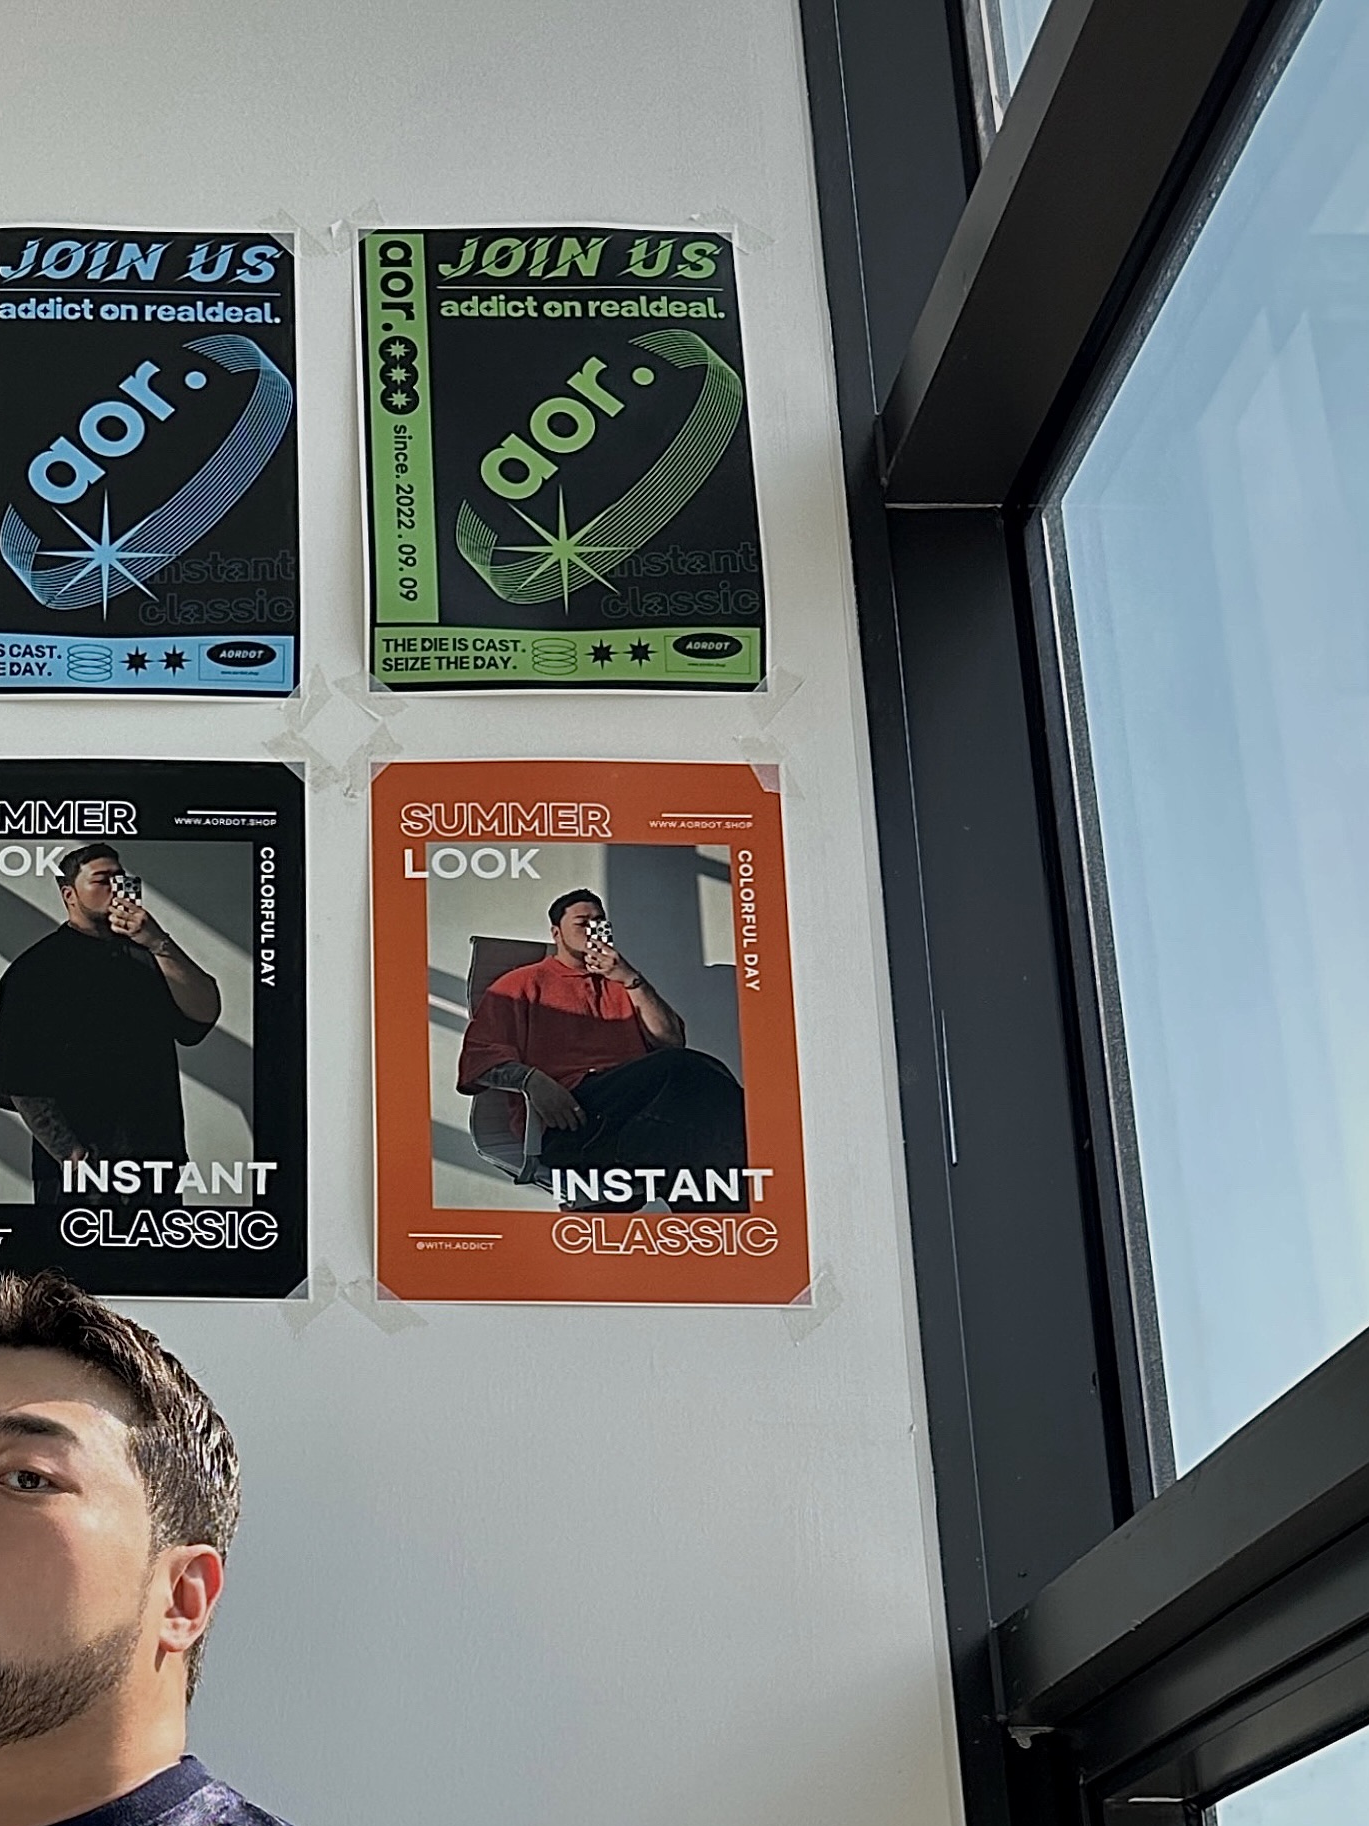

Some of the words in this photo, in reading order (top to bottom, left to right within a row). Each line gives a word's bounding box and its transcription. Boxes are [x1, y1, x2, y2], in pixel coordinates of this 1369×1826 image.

[0, 239, 174, 284] JOIN
[176, 241, 284, 284] US
[439, 236, 612, 281] JOIN
[616, 237, 722, 278] US
[0, 297, 93, 321] addict
[100, 303, 137, 321] on
[145, 302, 280, 324] realdeal.
[441, 295, 537, 318] addict
[544, 300, 582, 318] on
[589, 297, 725, 319] realdeal.
[393, 424, 413, 480] since.
[139, 588, 295, 624] classic
[601, 581, 758, 618] classic
[9, 645, 61, 660] CAST.
[382, 657, 433, 671] SEIZE
[436, 657, 471, 670] THE
[474, 657, 517, 670] DAY.
[383, 639, 417, 652] THE
[421, 639, 450, 652] DIE
[452, 639, 470, 652] IS
[472, 639, 526, 653] CAST.
[9, 662, 52, 676] DAY.
[400, 803, 612, 838] SUMMER
[404, 847, 540, 879] LOOK
[260, 846, 275, 944] COLORFUL
[737, 850, 759, 948] COLORFUL
[260, 948, 275, 988] DAY
[743, 953, 761, 991] DAY
[63, 1161, 277, 1194] INSTANT
[551, 1168, 773, 1202] INSTANT
[60, 1209, 278, 1250] CLASSIC
[551, 1217, 778, 1257] CLASSIC
